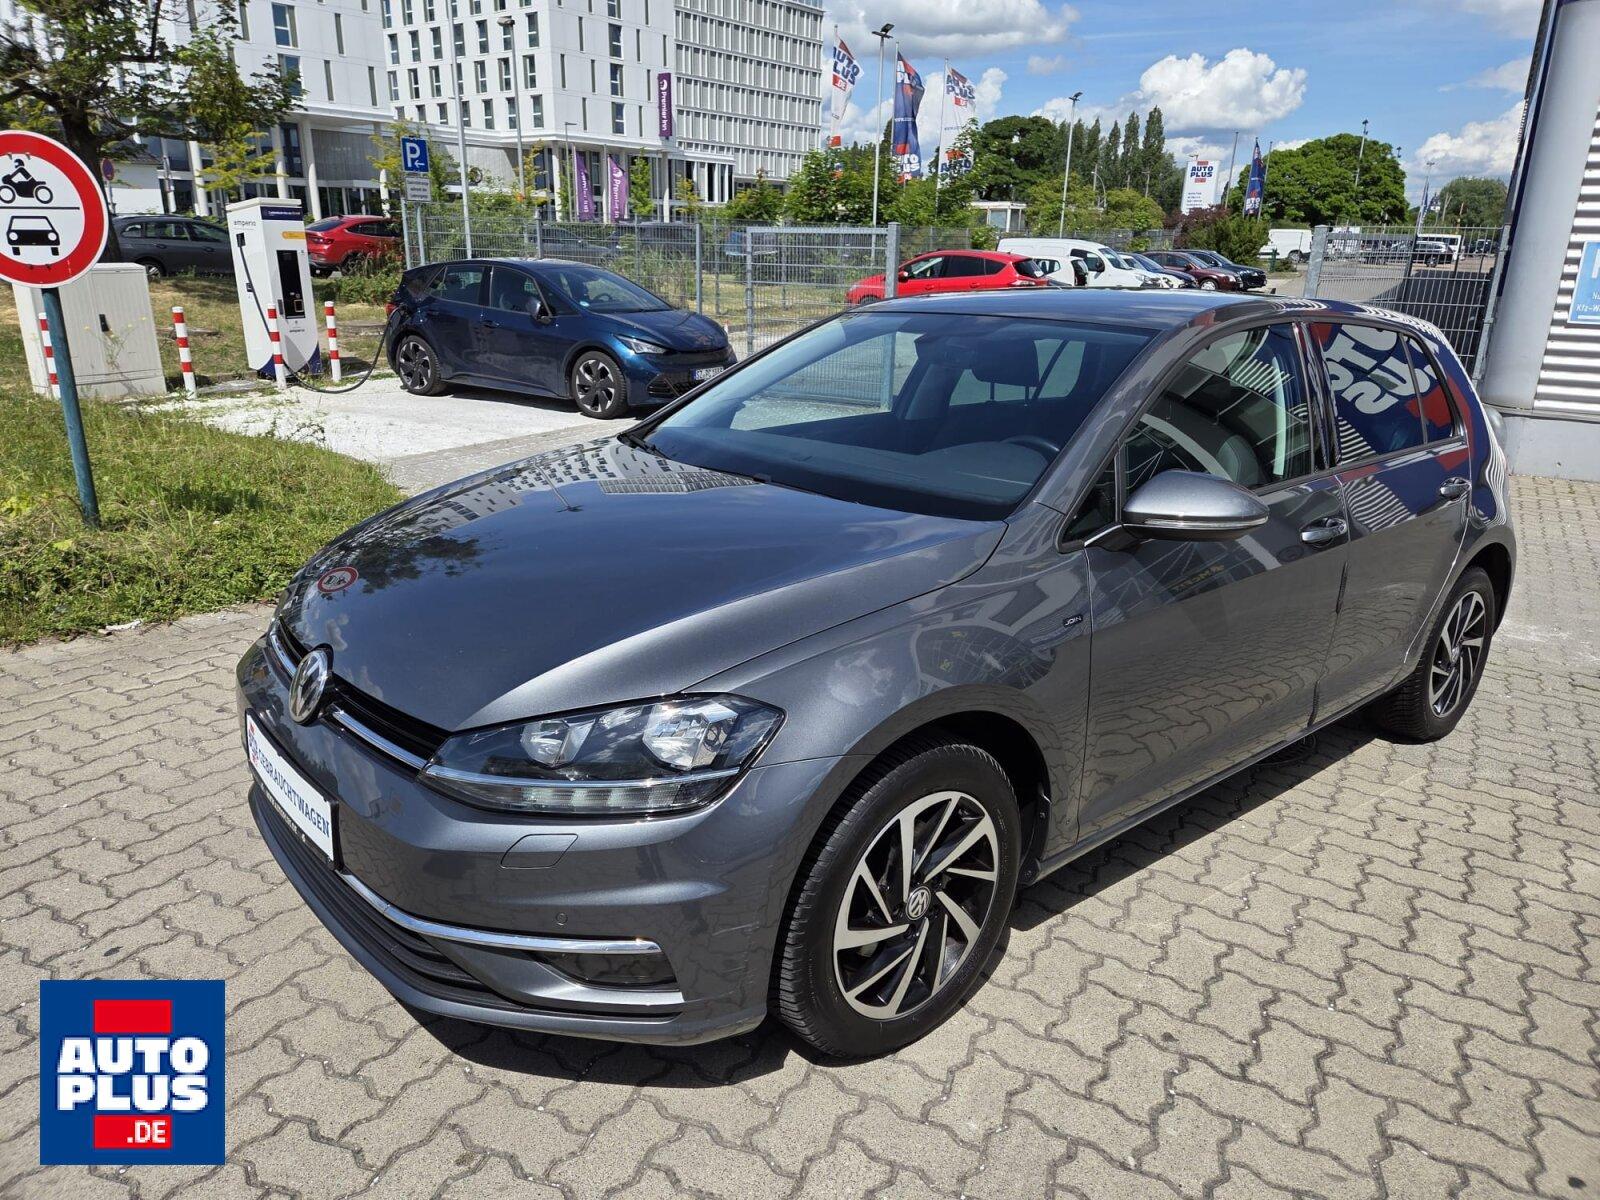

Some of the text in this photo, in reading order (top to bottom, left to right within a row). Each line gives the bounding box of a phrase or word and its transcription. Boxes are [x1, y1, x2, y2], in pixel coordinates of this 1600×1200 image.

[833, 61, 856, 86] LUS
[405, 142, 421, 168] P
[1065, 615, 1082, 626] JOIN
[258, 747, 330, 839] GEBRAUCHTWAGEN
